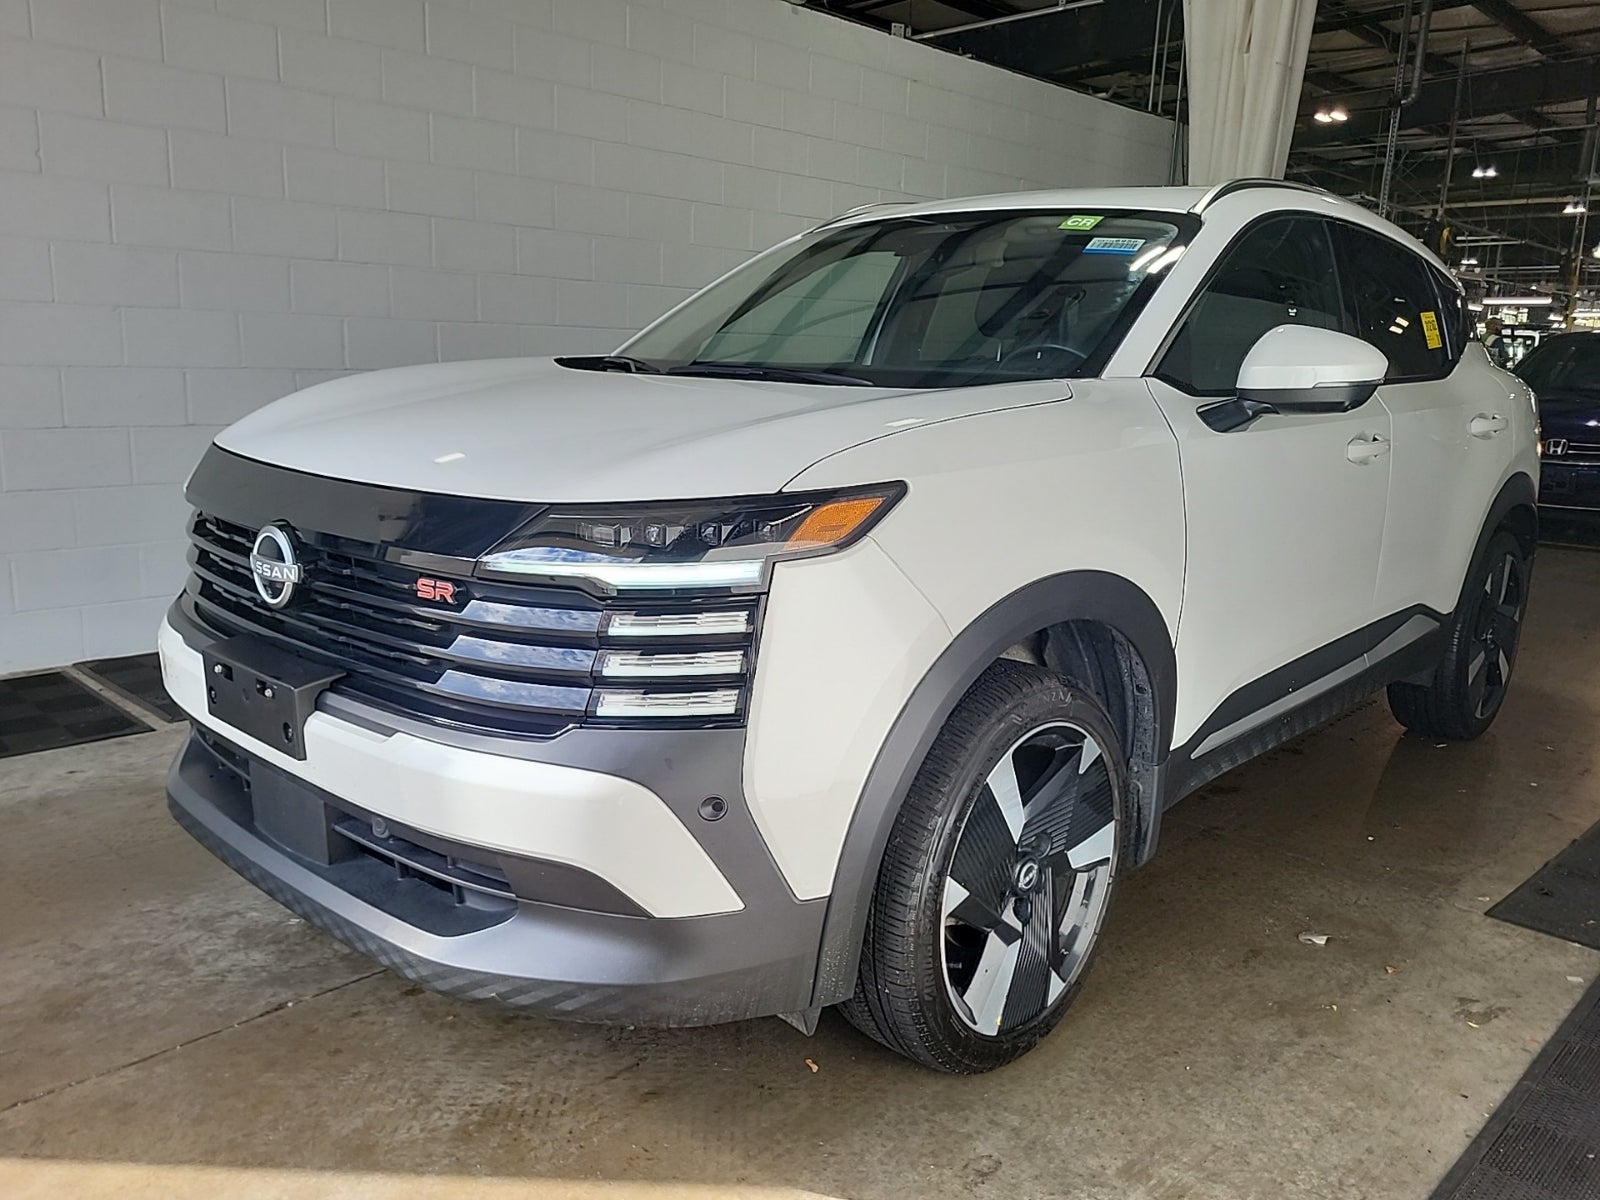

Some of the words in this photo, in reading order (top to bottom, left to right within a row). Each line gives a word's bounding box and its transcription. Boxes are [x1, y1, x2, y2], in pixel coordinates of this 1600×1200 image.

[1067, 217, 1095, 227] CR
[255, 560, 295, 580] SSAN
[416, 577, 455, 604] SR
